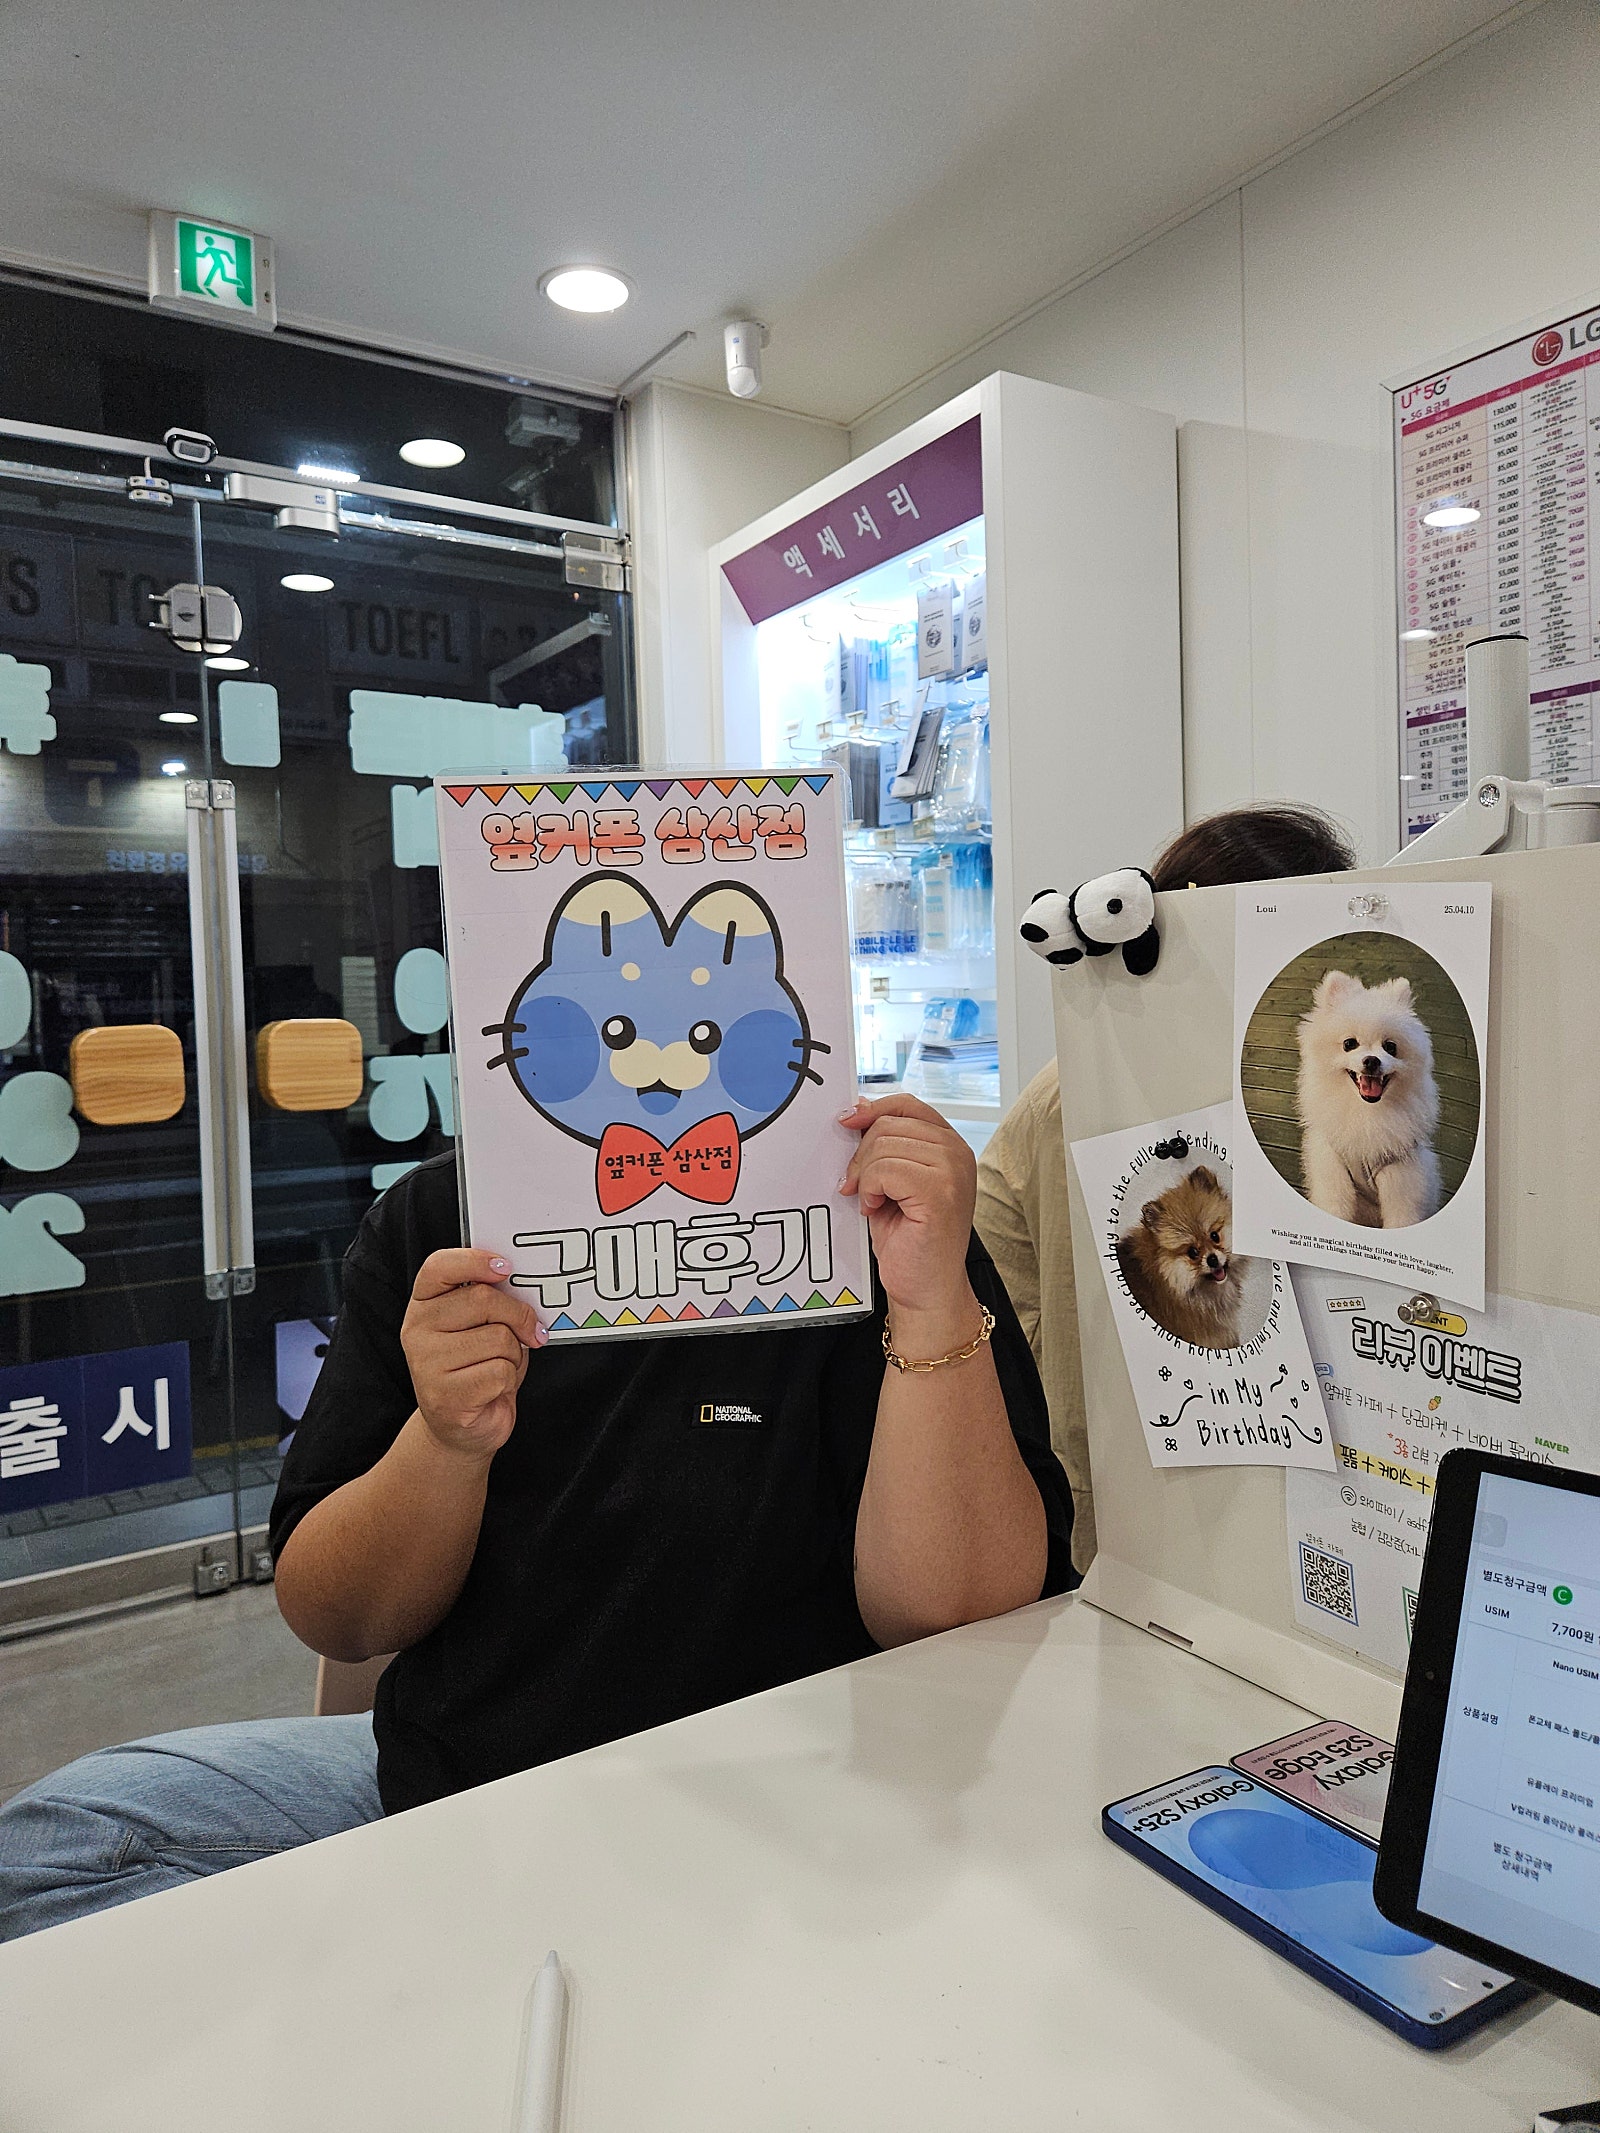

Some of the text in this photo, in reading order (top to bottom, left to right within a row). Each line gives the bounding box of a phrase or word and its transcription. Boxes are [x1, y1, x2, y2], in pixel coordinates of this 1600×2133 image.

[1425, 398, 1450, 414] 요금제
[1493, 416, 1518, 430] 115,000
[783, 483, 920, 578] 액세서리
[340, 602, 460, 663] TOEFL
[481, 802, 808, 872] 옆커폰 삼산점
[1256, 904, 1277, 914] Loui
[1444, 904, 1475, 916] 25.04.10
[604, 1145, 733, 1180] 옆커폰 삼산점
[1113, 1174, 1131, 1202] the
[1107, 1206, 1120, 1226] to
[510, 1204, 834, 1308] 구매후기
[1104, 1231, 1120, 1262] day
[1271, 1229, 1298, 1240] Wishing
[1319, 1237, 1344, 1247] magical
[1346, 1241, 1374, 1252] birthday
[1375, 1247, 1393, 1256] filled
[1394, 1253, 1408, 1261] with
[1326, 1245, 1347, 1254] things
[1349, 1249, 1363, 1257] that
[1364, 1252, 1381, 1261] make
[1383, 1257, 1397, 1265] your
[1399, 1260, 1415, 1270] heart
[1416, 1265, 1438, 1276] happy.
[1273, 1262, 1283, 1293] ove
[1110, 1268, 1147, 1321] special
[1268, 1300, 1281, 1334] and
[1151, 1322, 1181, 1350] your
[1189, 1346, 1233, 1367] Enjoy
[1352, 1316, 1522, 1404] 리뷰 이벤트
[1208, 1377, 1263, 1407] in My
[715, 1406, 752, 1414] NATIONAL
[715, 1413, 762, 1422] GEOGRAPHIC
[1324, 1382, 1352, 1406] 옆커폰
[1357, 1393, 1383, 1414] 카페
[1402, 1406, 1448, 1438] 당근마켓
[1468, 1429, 1503, 1454] 네이버
[1196, 1414, 1292, 1448] Birthday
[1412, 1446, 1429, 1465] 리뷰
[1534, 1436, 1570, 1454] NAVER
[1378, 1462, 1413, 1487] 케이스
[1360, 1495, 1396, 1519] 와이파이
[1483, 1569, 1547, 1596] 별도청구금액
[1485, 1604, 1510, 1618] USIM
[1552, 1622, 1594, 1644] 7,700원
[1553, 1660, 1599, 1680] Nano USIM
[1462, 1706, 1499, 1725] 상품설명
[1528, 1714, 1552, 1730] 폰교체
[1554, 1723, 1570, 1735] 패스
[1325, 1735, 1374, 1758] S25
[1264, 1750, 1336, 1781] Edge
[1175, 1779, 1255, 1815] Galaxy
[1527, 1777, 1593, 1808] 유플레이 프리미엄
[1132, 1808, 1182, 1833] S25+
[1511, 1803, 1540, 1821] V컬러링
[1493, 1842, 1552, 1873] 별도 청구금액
[1502, 1860, 1539, 1882] 상세내역
